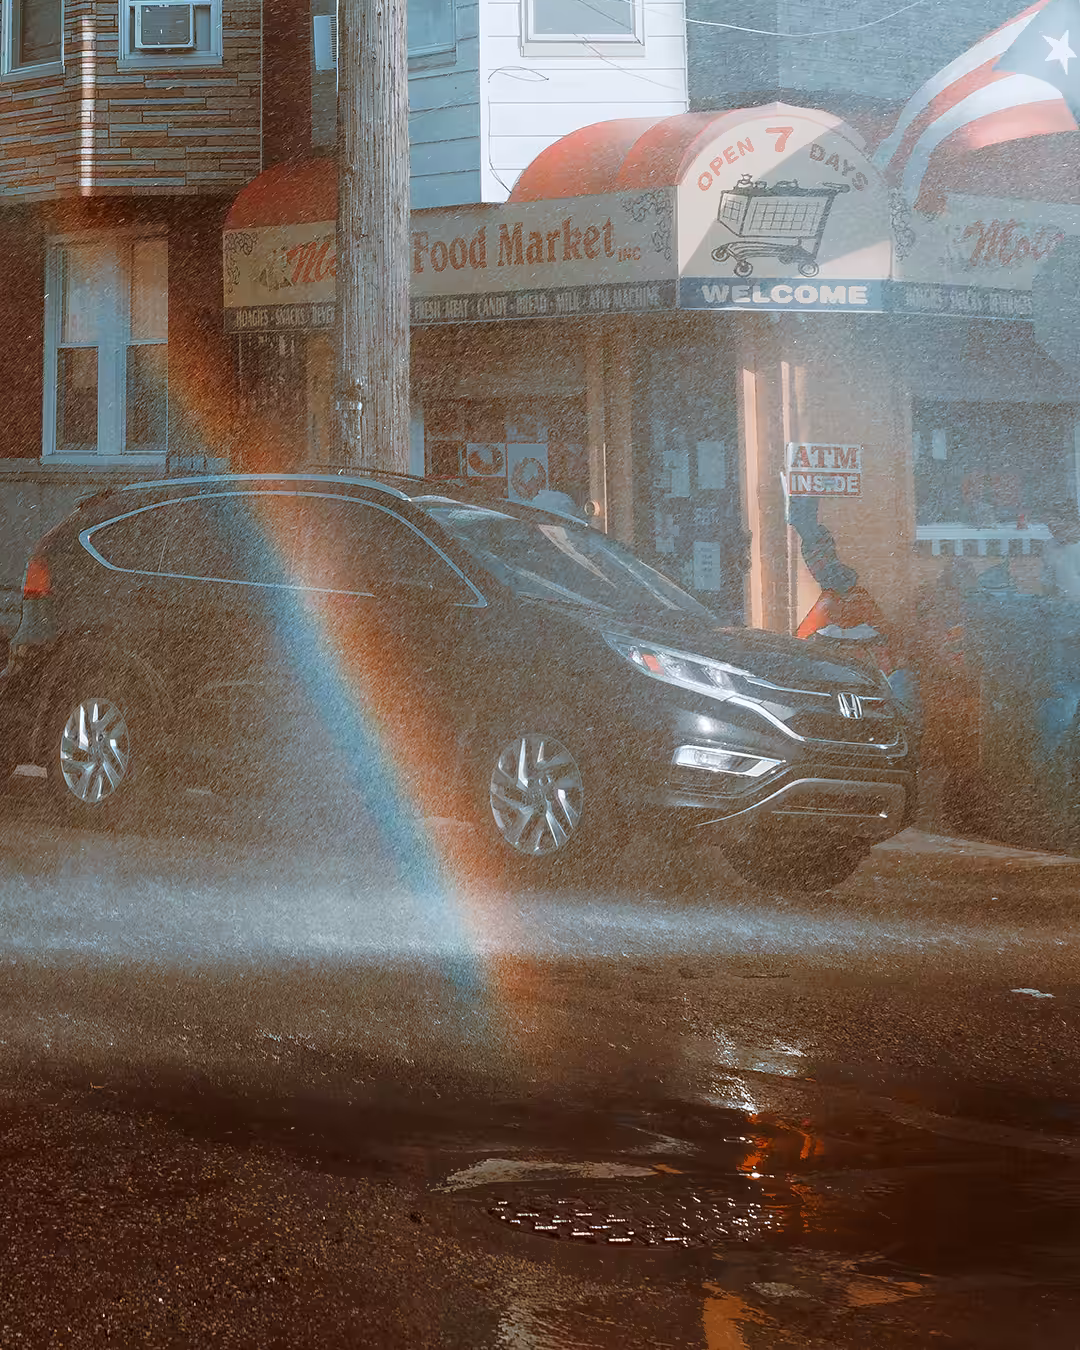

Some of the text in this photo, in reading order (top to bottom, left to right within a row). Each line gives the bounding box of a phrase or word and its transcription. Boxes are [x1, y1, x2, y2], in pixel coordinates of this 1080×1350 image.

[697, 126, 869, 191] OPEN 7 DAYS
[410, 225, 488, 274] Food
[497, 217, 616, 267] Market
[477, 295, 508, 316] CANDY
[700, 284, 869, 305] WELCOME
[791, 445, 859, 469] ATM
